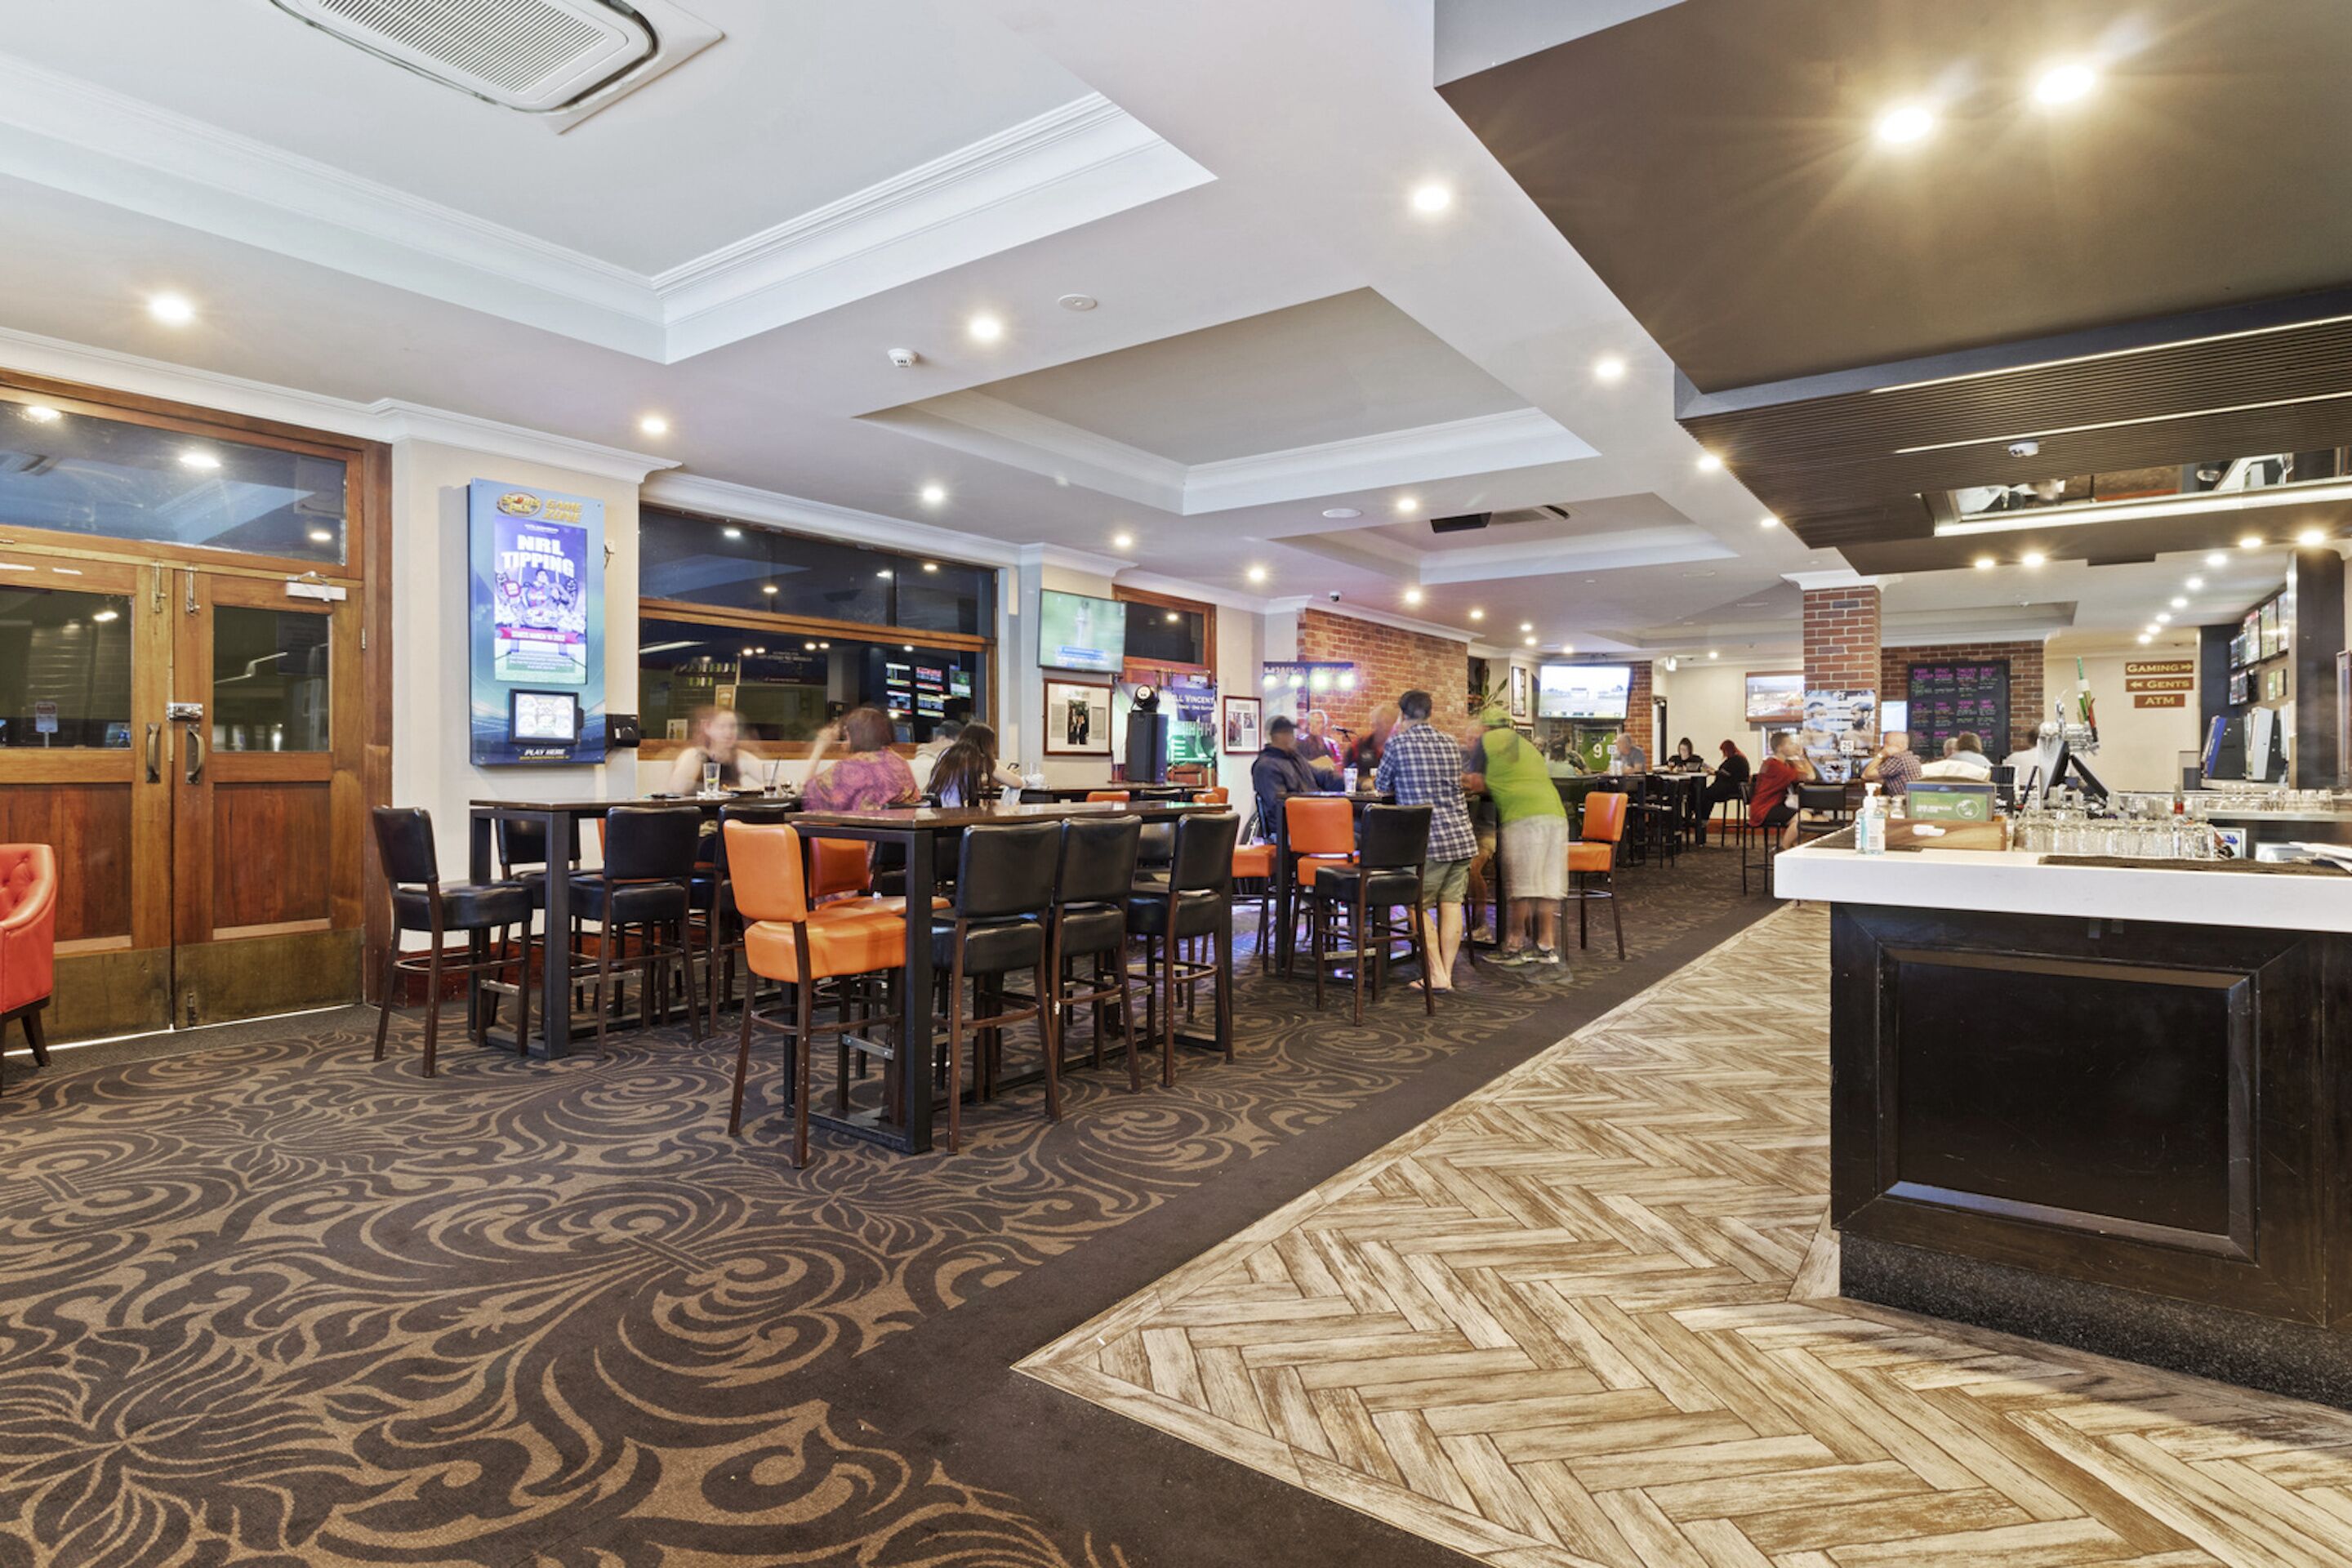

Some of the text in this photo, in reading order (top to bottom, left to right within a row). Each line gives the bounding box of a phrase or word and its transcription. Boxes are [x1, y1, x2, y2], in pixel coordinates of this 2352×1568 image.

[546, 498, 582, 511] GAME
[542, 509, 581, 523] ZONE
[517, 534, 565, 556] NRL
[501, 551, 575, 578] TIPPING
[2127, 664, 2179, 673] GAMING
[2147, 679, 2189, 688] GENTS
[2145, 696, 2176, 705] ATM
[524, 748, 546, 756] PLAY
[1593, 743, 1602, 759] 9
